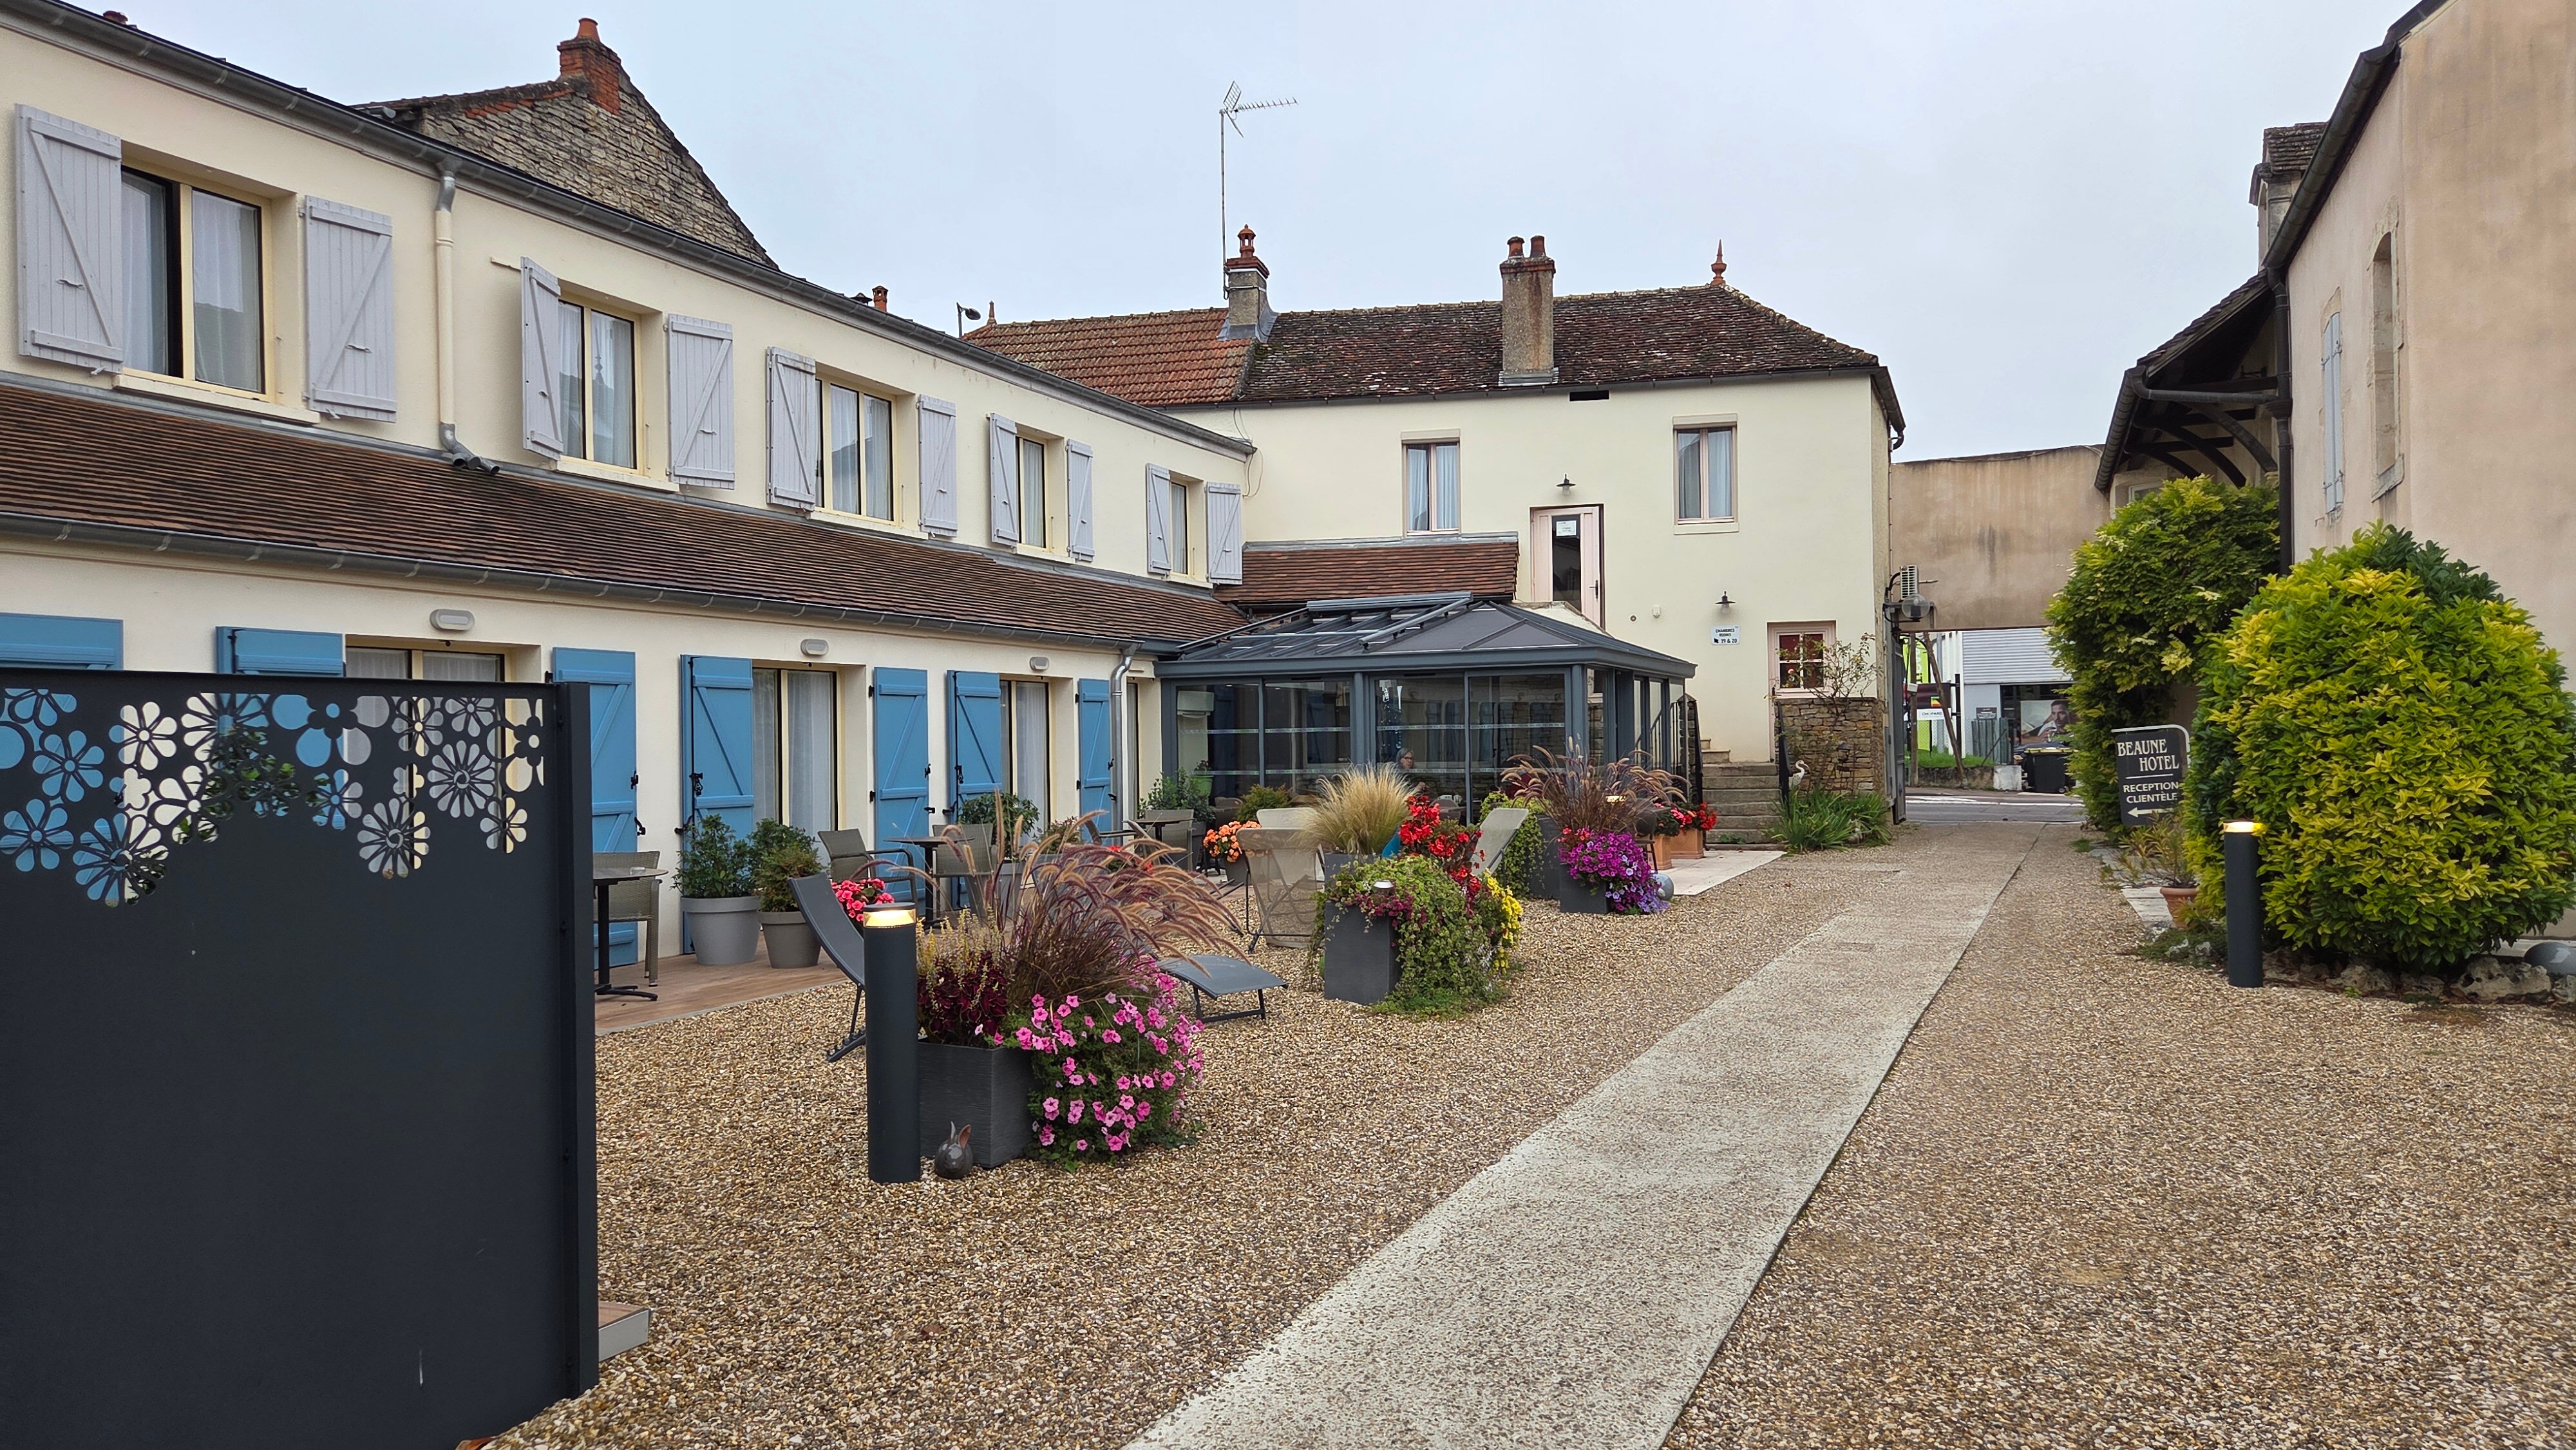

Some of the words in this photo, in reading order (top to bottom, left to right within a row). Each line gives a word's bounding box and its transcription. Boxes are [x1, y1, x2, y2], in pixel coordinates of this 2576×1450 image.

[2117, 739, 2167, 757] BEAUNE
[2139, 755, 2179, 771] HOTEL
[2123, 782, 2179, 793] RECEPTION
[2126, 791, 2177, 804] CLIENTÈLE
